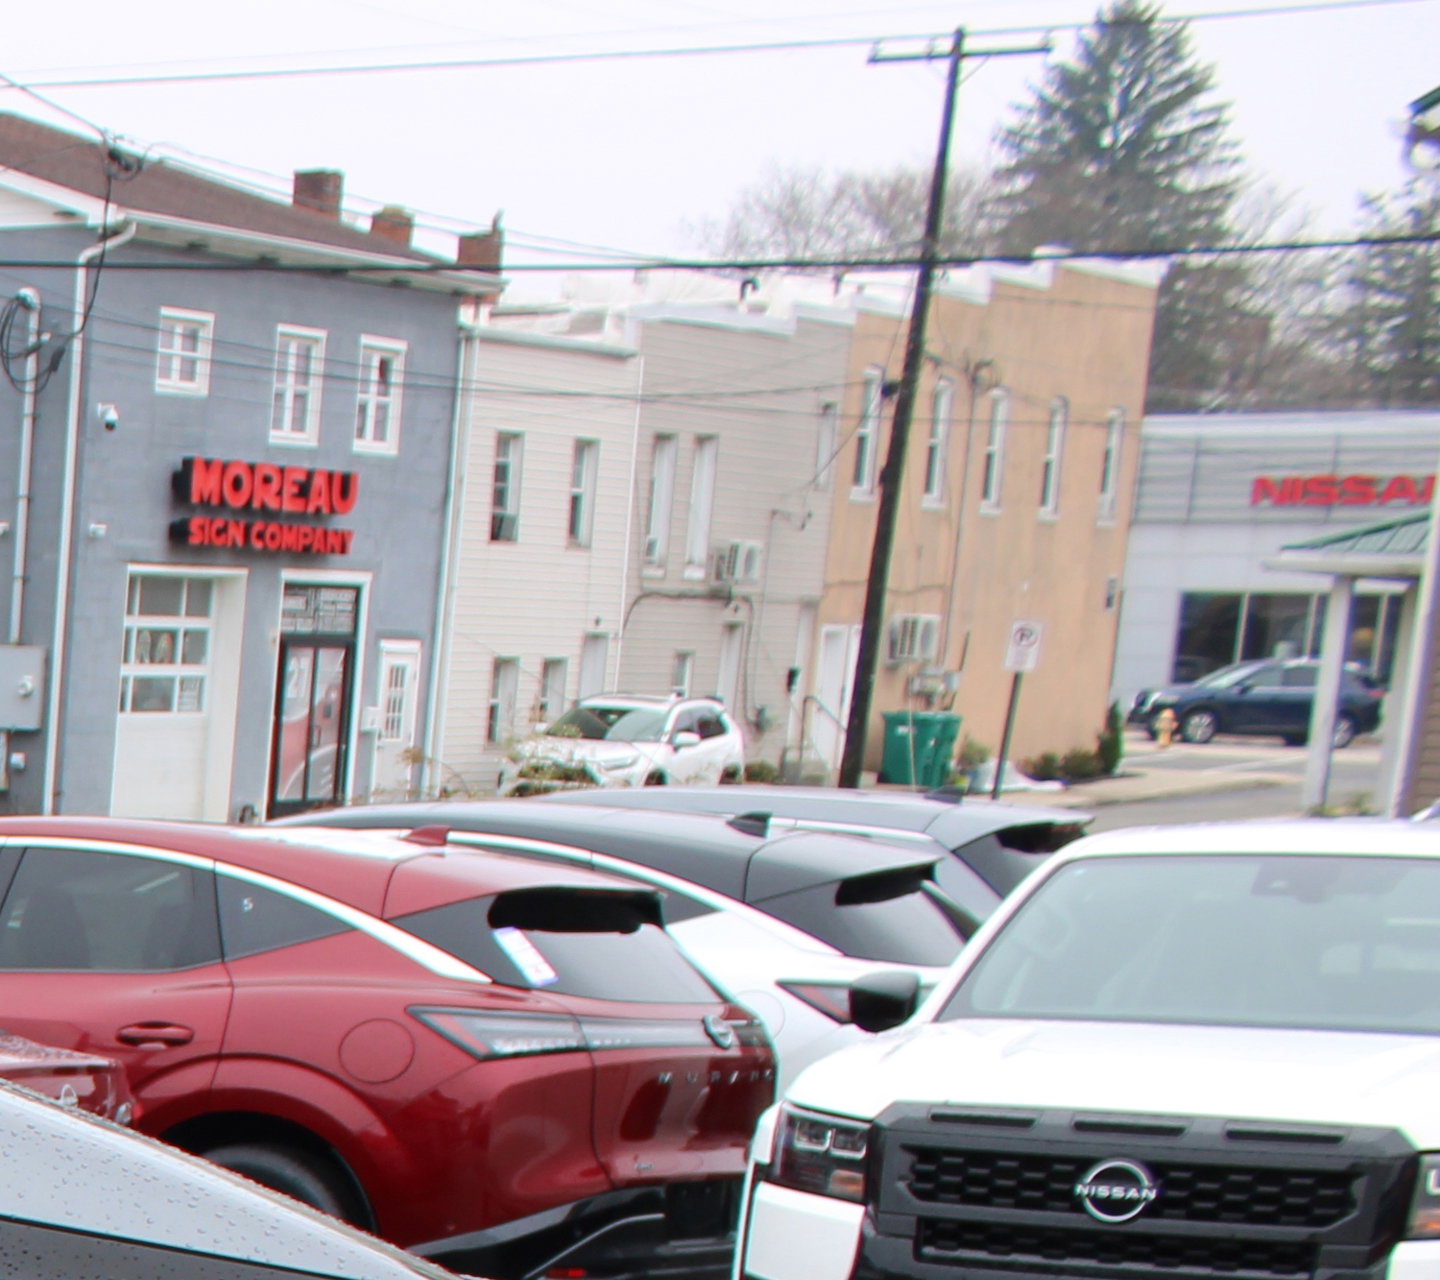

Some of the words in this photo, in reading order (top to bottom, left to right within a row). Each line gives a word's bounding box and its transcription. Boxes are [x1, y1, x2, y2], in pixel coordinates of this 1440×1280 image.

[191, 456, 360, 515] MOREAU
[187, 516, 247, 548] SIGN
[250, 519, 356, 555] COMPANY
[1076, 1184, 1158, 1201] NISSAN
